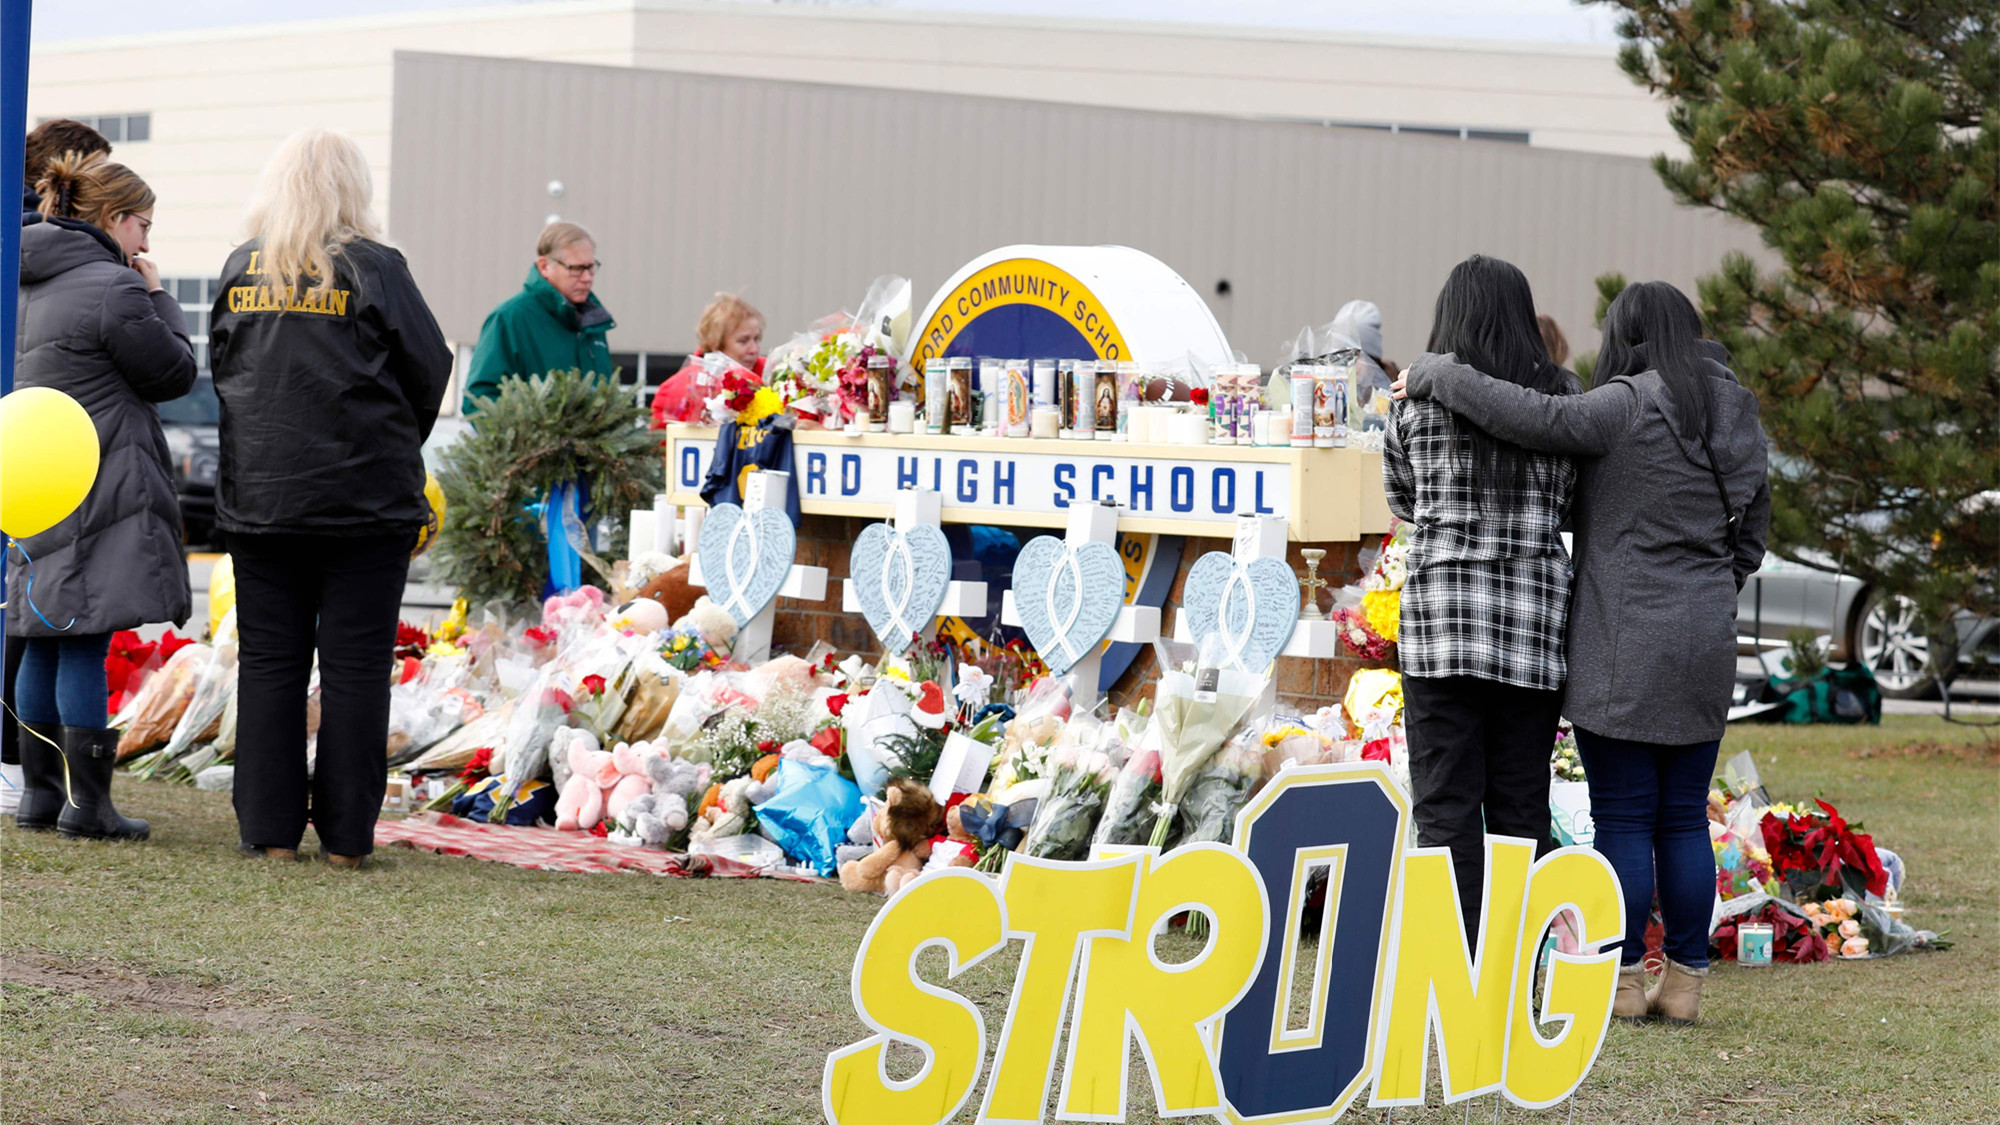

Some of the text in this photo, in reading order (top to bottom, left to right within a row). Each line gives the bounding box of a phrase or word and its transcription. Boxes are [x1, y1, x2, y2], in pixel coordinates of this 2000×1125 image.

[914, 274, 1120, 379] FORD COMMUNITY SCHO
[682, 446, 861, 497] ORD
[898, 456, 1016, 506] HIGH
[1053, 463, 1274, 514] SCHOOL
[822, 760, 1626, 1125] STRONG
